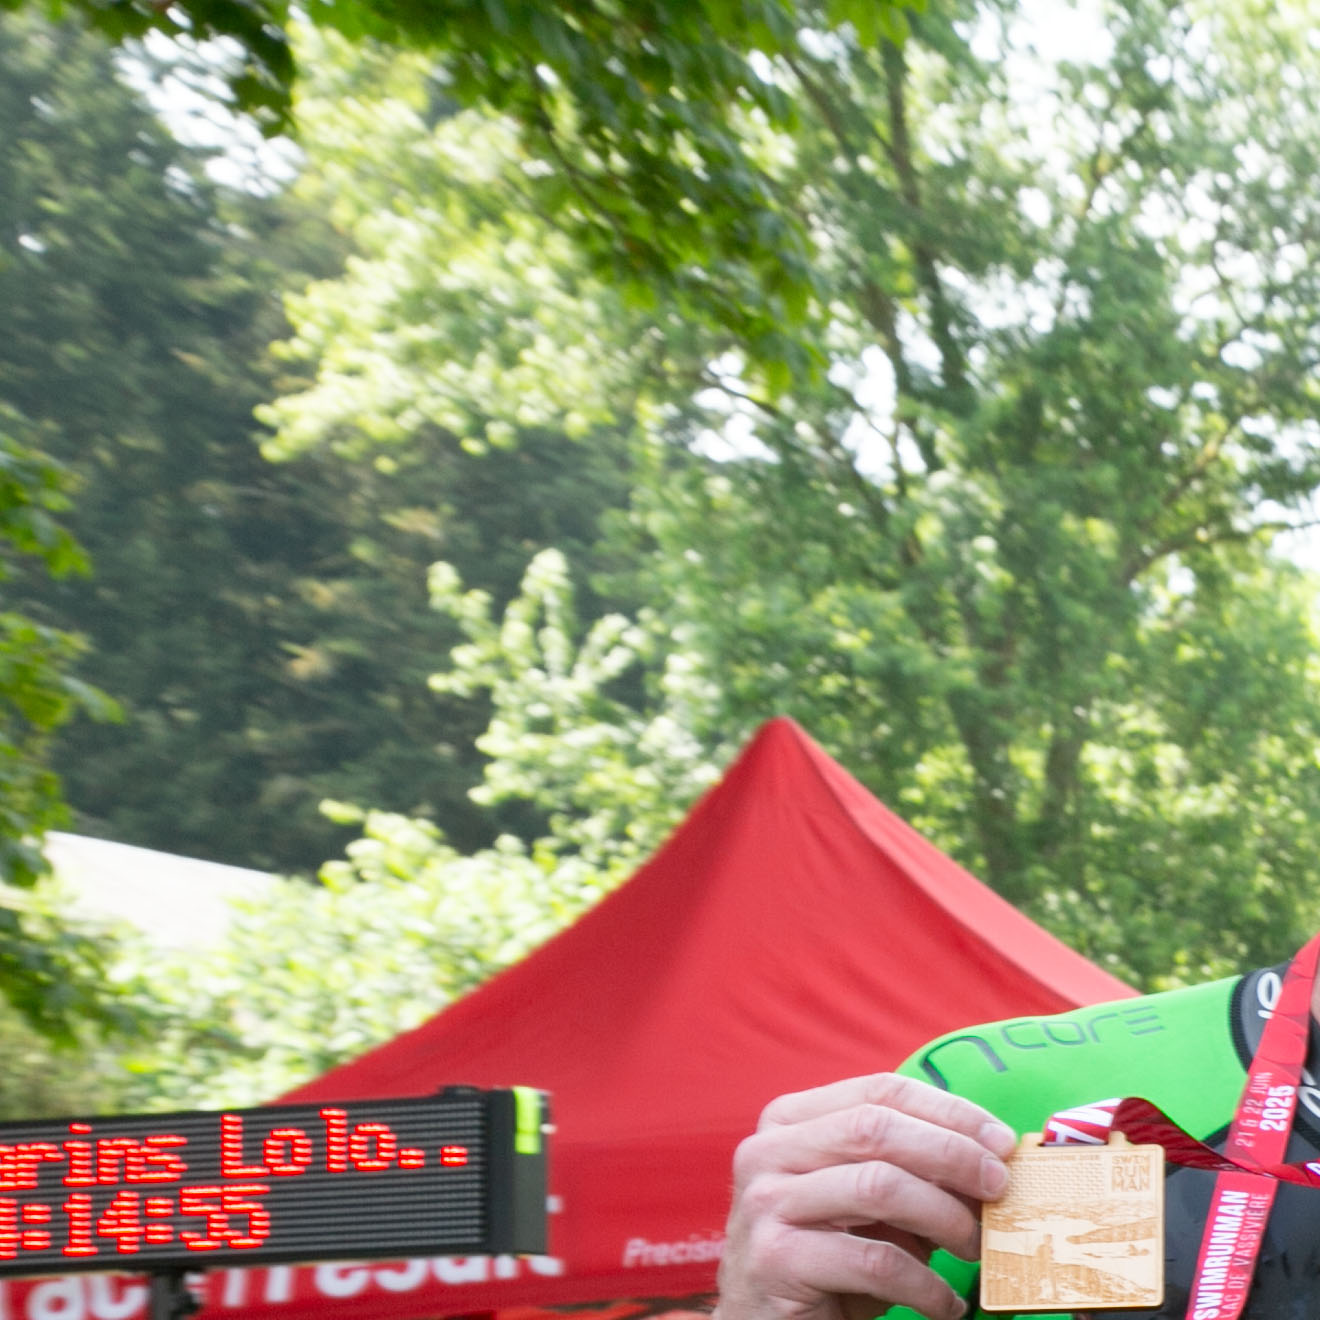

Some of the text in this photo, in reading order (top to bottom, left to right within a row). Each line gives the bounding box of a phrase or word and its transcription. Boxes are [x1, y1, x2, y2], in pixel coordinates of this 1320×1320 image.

[1251, 1071, 1274, 1095] JUIN
[1244, 1099, 1264, 1116] 22
[1260, 1085, 1296, 1131] 2025
[1228, 1272, 1248, 1289] DE
[1218, 1292, 1242, 1319] LAC
